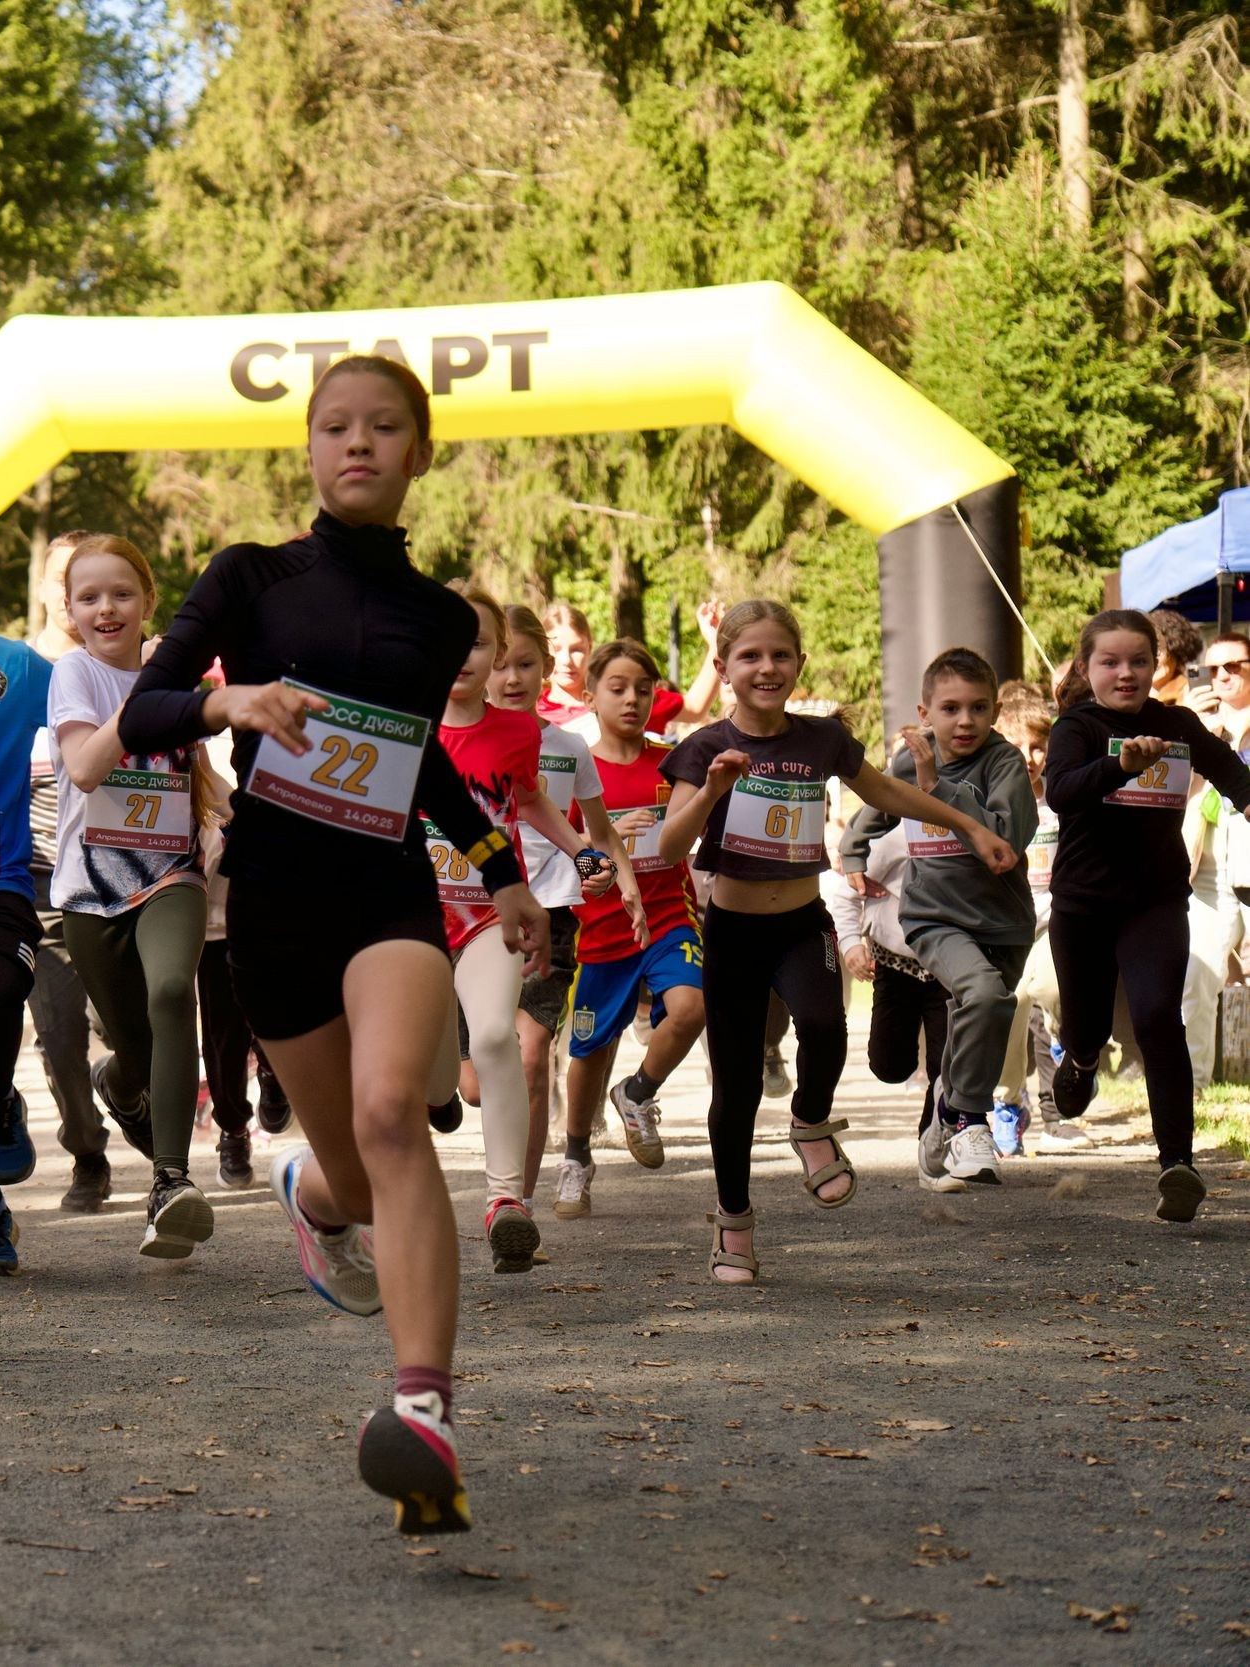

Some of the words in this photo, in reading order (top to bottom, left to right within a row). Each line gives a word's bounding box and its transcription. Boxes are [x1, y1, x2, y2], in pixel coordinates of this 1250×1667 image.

[305, 703, 363, 725] ОСС
[362, 714, 415, 739] ДУБКИ
[147, 776, 183, 788] ДУБКИ
[310, 734, 379, 797] 22
[781, 761, 812, 777] CUTE
[267, 781, 334, 814] Апрелевка
[343, 808, 394, 829] 14.09.25
[746, 781, 790, 797] КРОСС
[790, 788, 821, 800] ДУБКИ
[124, 793, 162, 829] 27
[764, 804, 803, 840] 61
[95, 832, 141, 843] Апрелевка
[147, 838, 181, 847] 14.09.25
[734, 839, 780, 854] Апрелевка
[430, 844, 470, 881] 28
